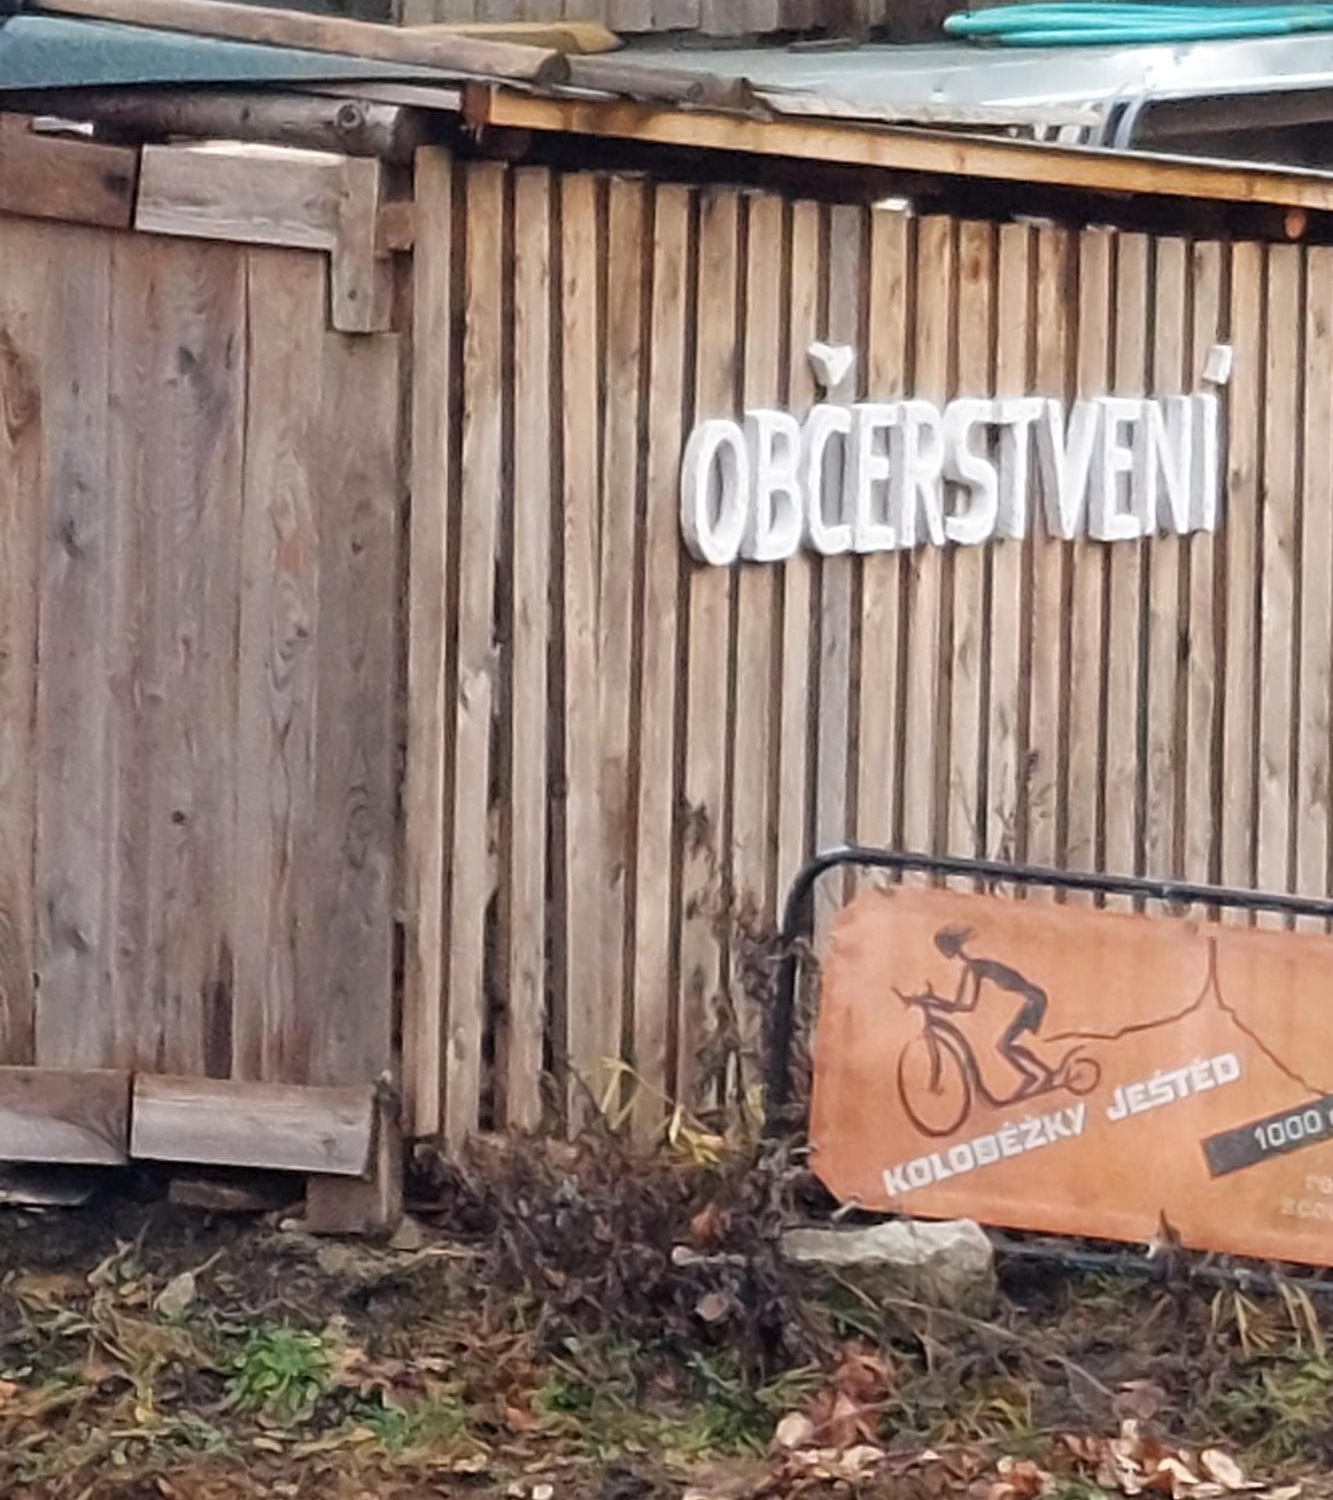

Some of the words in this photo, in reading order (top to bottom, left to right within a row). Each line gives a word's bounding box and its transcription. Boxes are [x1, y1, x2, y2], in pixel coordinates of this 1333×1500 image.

[680, 341, 1233, 566] OBČERSTVENÍ
[882, 1102, 1085, 1197] KOLOBĚŽKY
[1253, 1109, 1323, 1150] 1000
